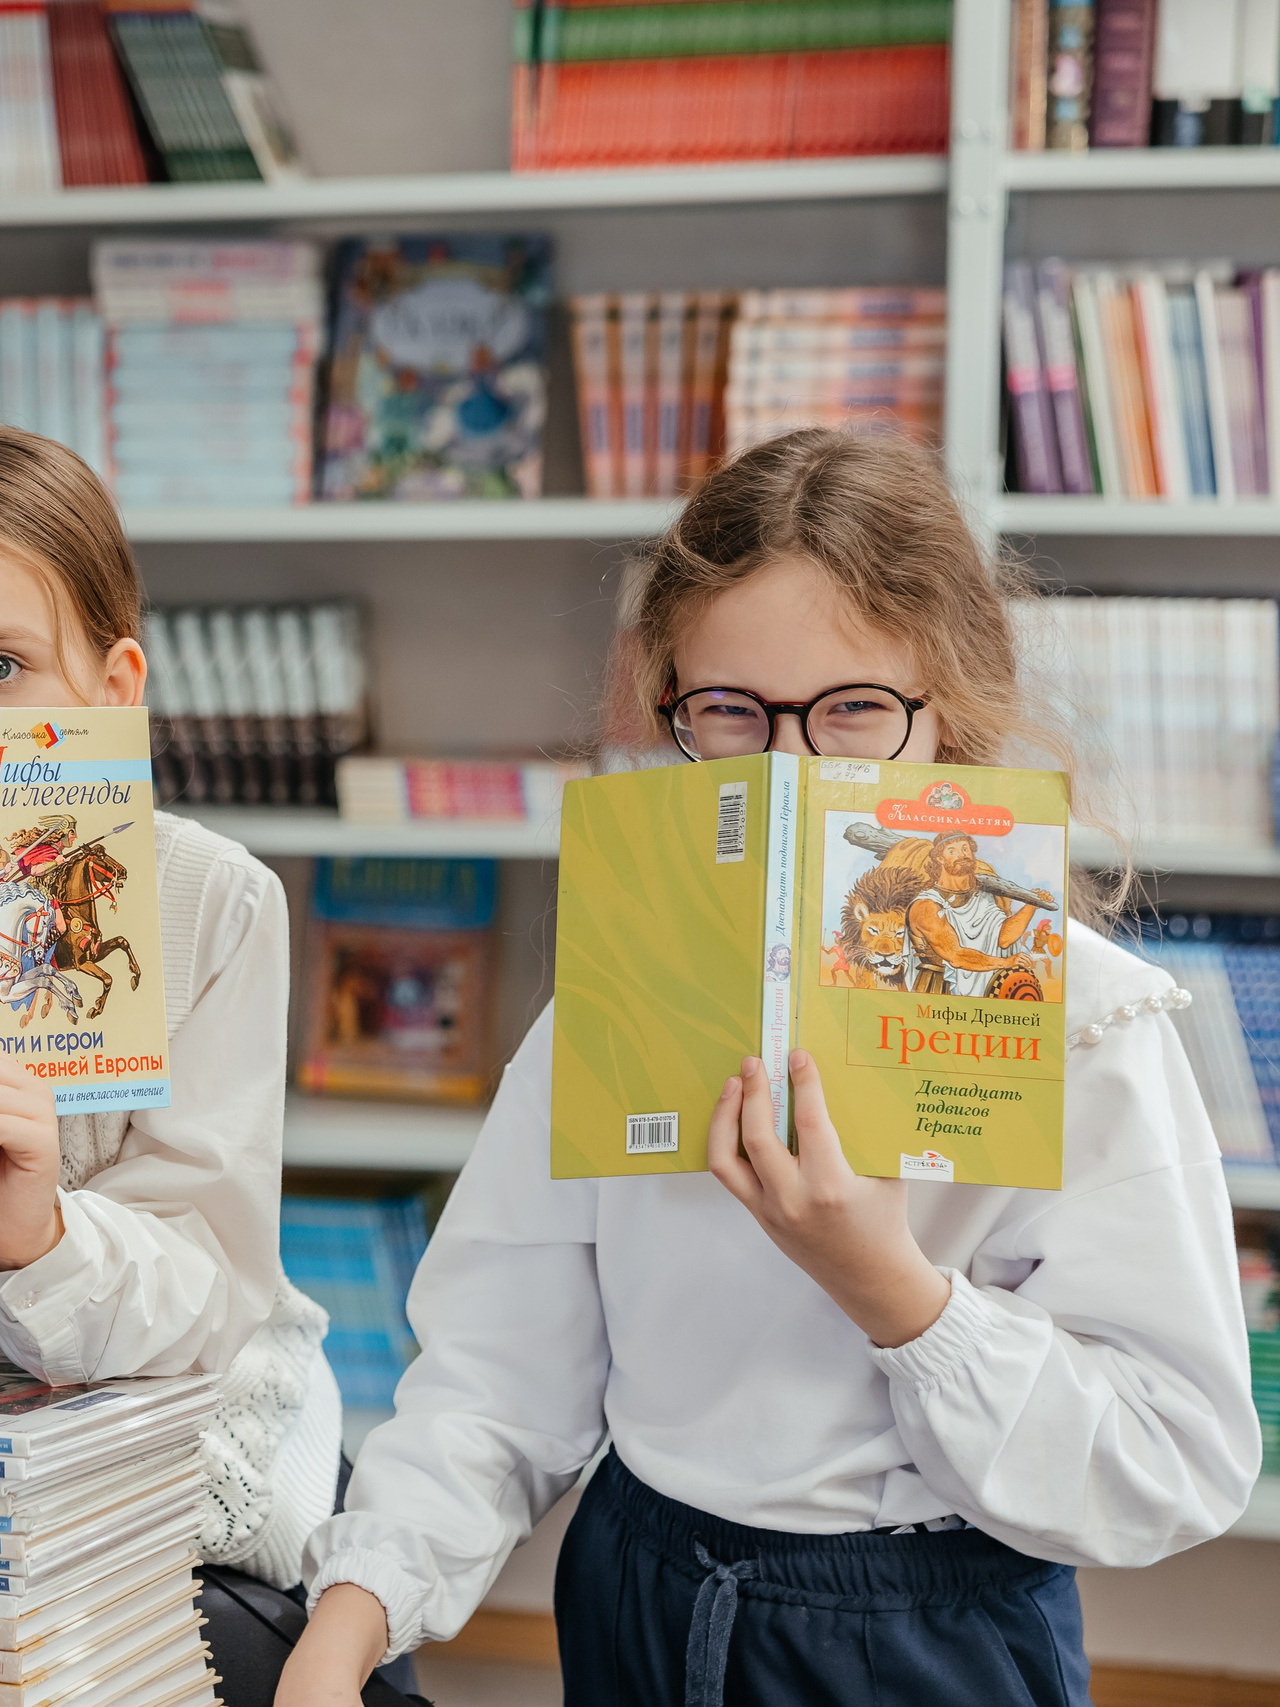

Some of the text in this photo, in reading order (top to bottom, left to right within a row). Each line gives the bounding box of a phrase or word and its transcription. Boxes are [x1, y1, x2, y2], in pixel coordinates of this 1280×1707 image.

[2, 728, 89, 740] Классика детям
[2, 777, 131, 807] и легенды
[775, 781, 792, 937] Двенадцать подвигов Геракла
[771, 988, 786, 1031] Греции
[916, 1003, 1040, 1028] Мифы Древней
[31, 1034, 41, 1053] и
[47, 1031, 103, 1055] герои
[876, 1015, 1041, 1065] Греции
[23, 1054, 163, 1078] евней Европы
[770, 1035, 785, 1089] Древней
[68, 1093, 74, 1102] и
[76, 1089, 130, 1101] внеклассное
[131, 1086, 164, 1097] чтение
[915, 1079, 1022, 1101] Двенадцать
[916, 1099, 990, 1117] подвигов
[915, 1116, 982, 1137] Геракла
